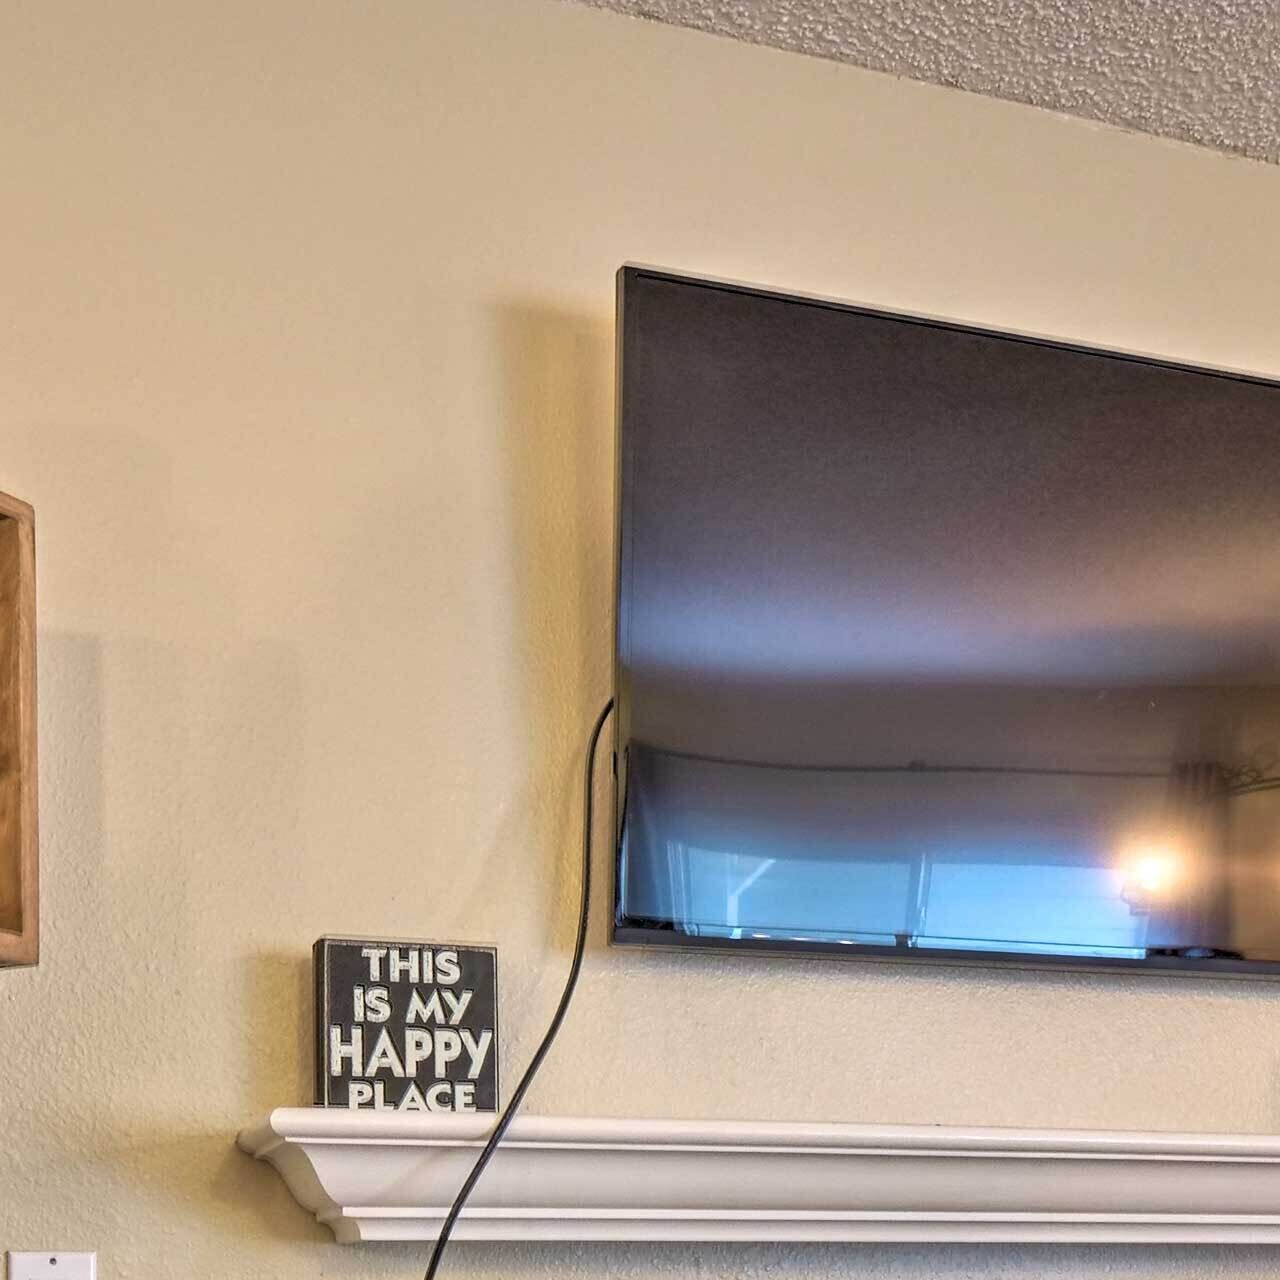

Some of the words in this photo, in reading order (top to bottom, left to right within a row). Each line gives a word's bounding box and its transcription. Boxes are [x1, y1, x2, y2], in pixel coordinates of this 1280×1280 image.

[361, 948, 462, 985] THIS
[353, 985, 392, 1023] IS
[405, 988, 474, 1025] MY
[330, 1025, 493, 1079] HAPPY
[348, 1080, 477, 1112] PLACE
